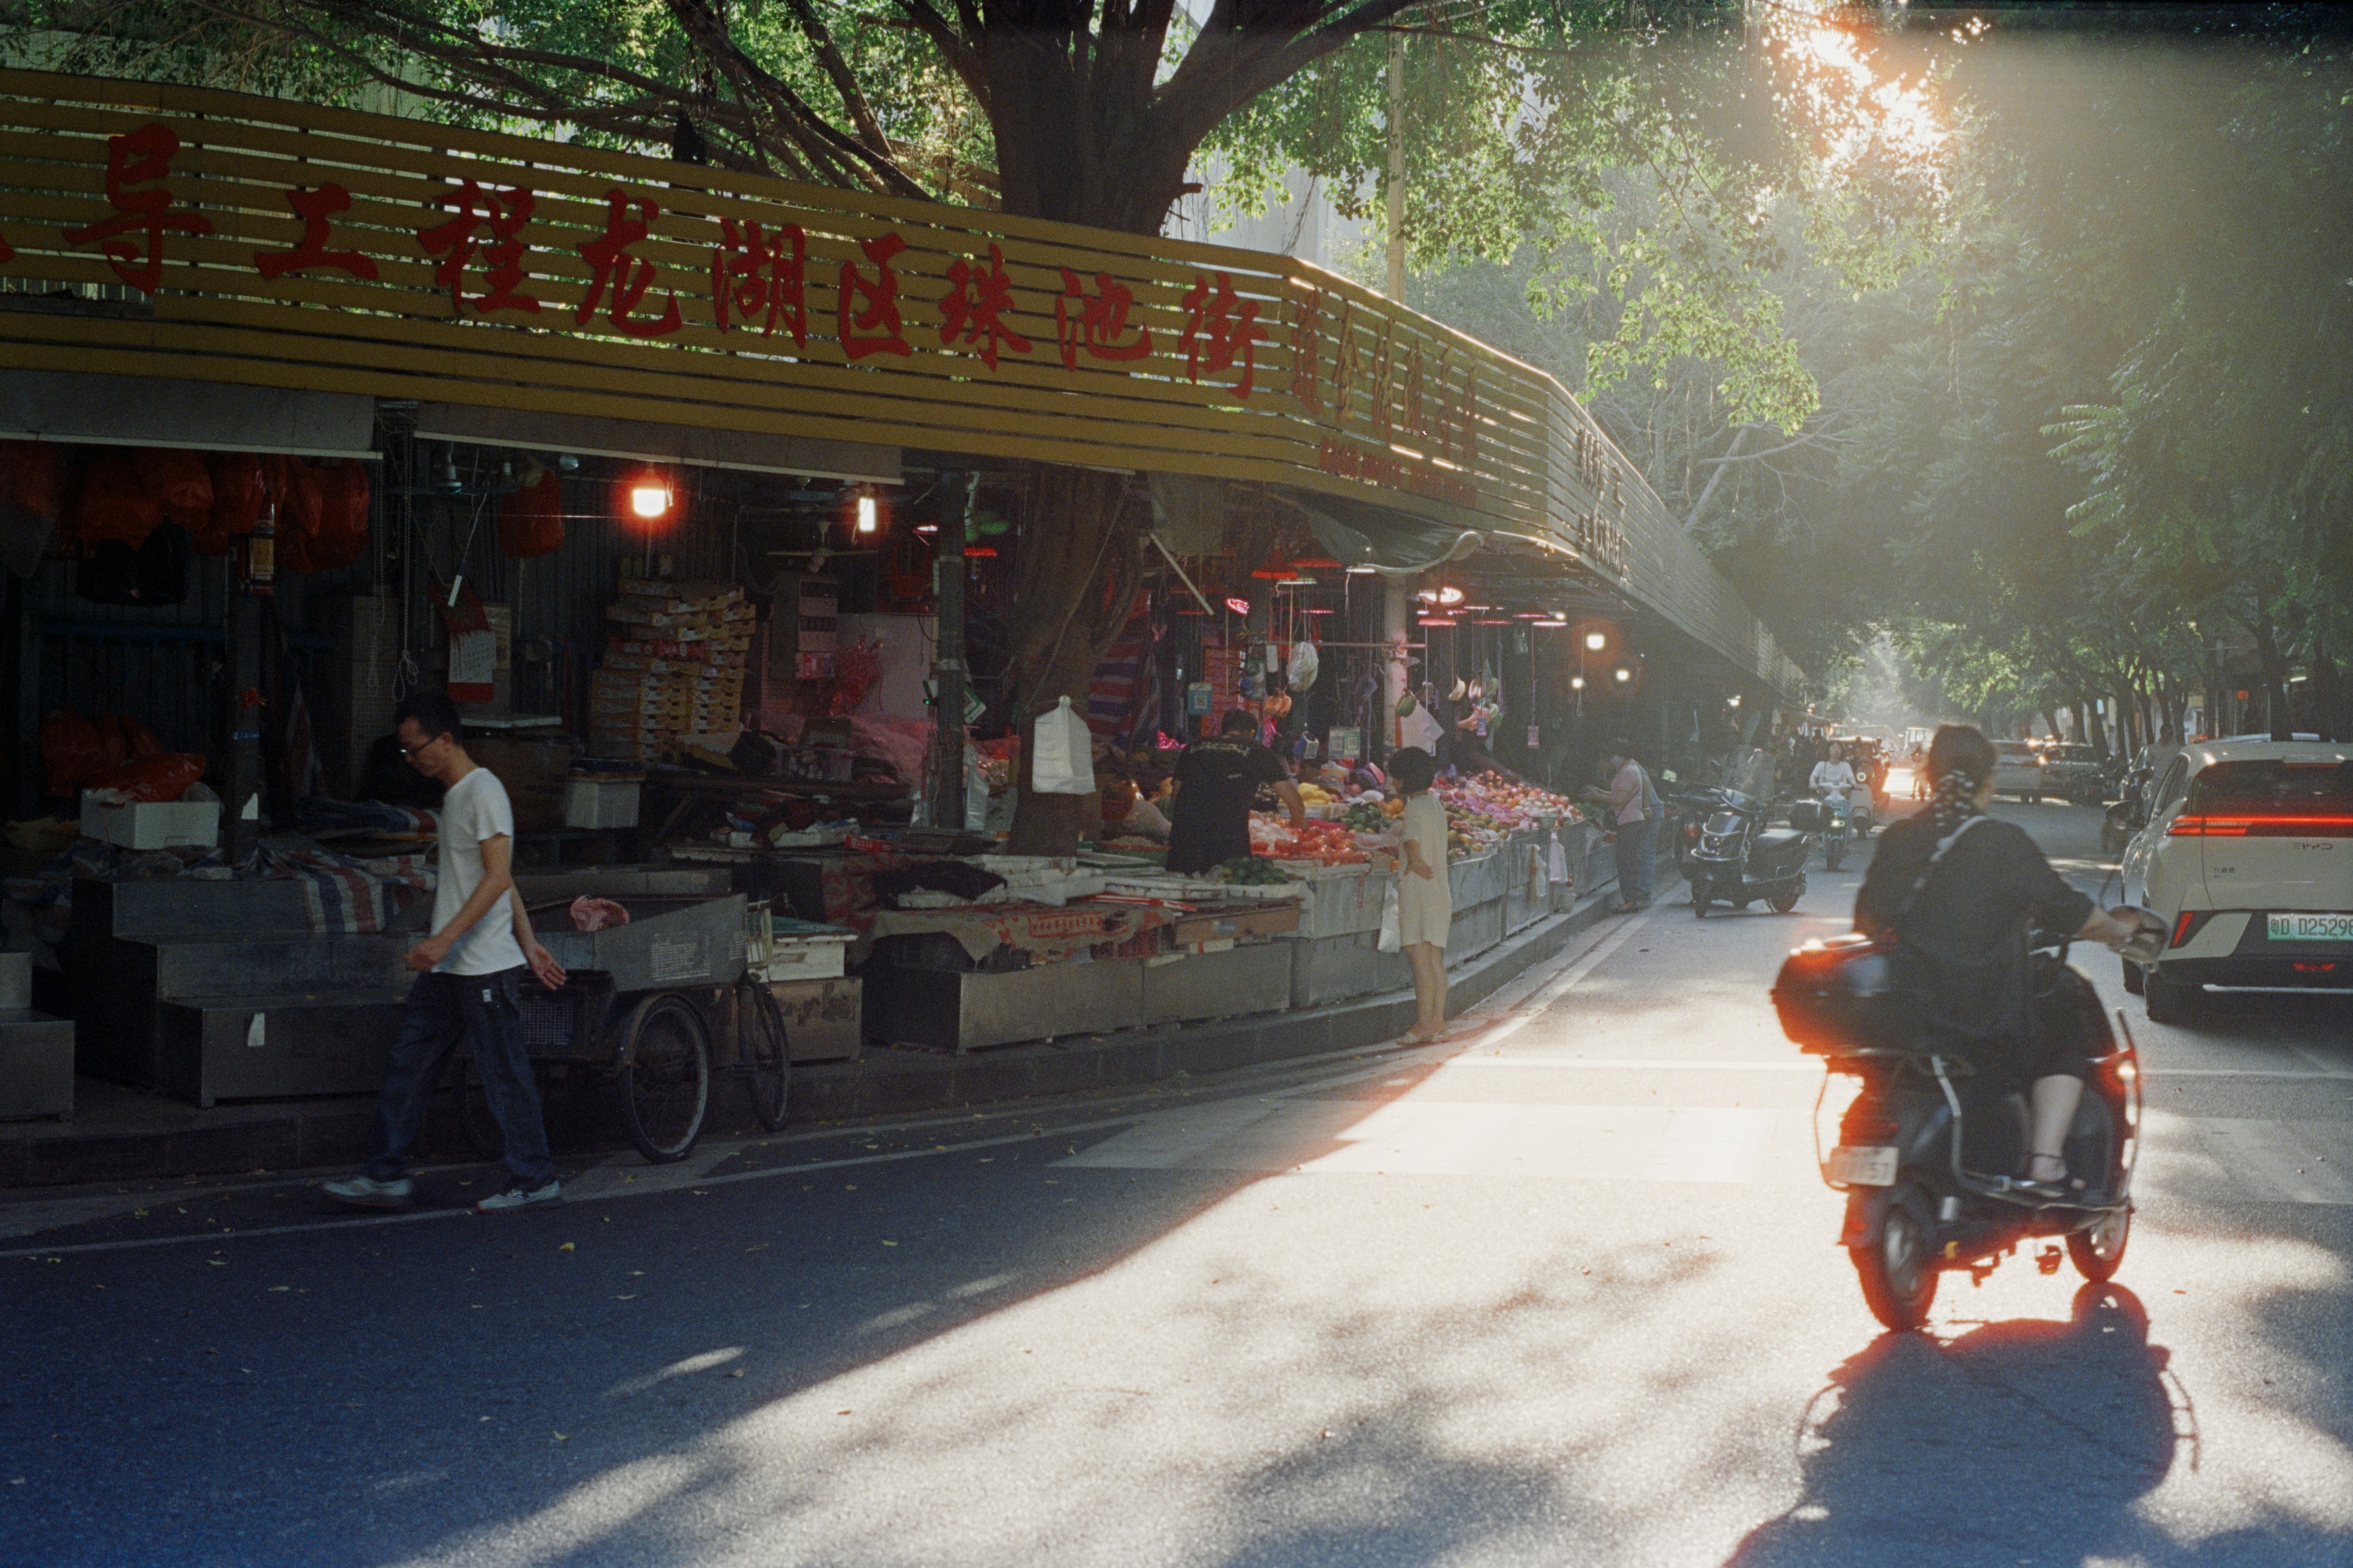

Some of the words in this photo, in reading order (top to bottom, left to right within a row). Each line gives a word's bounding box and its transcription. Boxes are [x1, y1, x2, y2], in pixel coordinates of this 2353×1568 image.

[0, 123, 1268, 399] 导工程龙湖区珠池街
[2293, 842, 2333, 850] BYD
